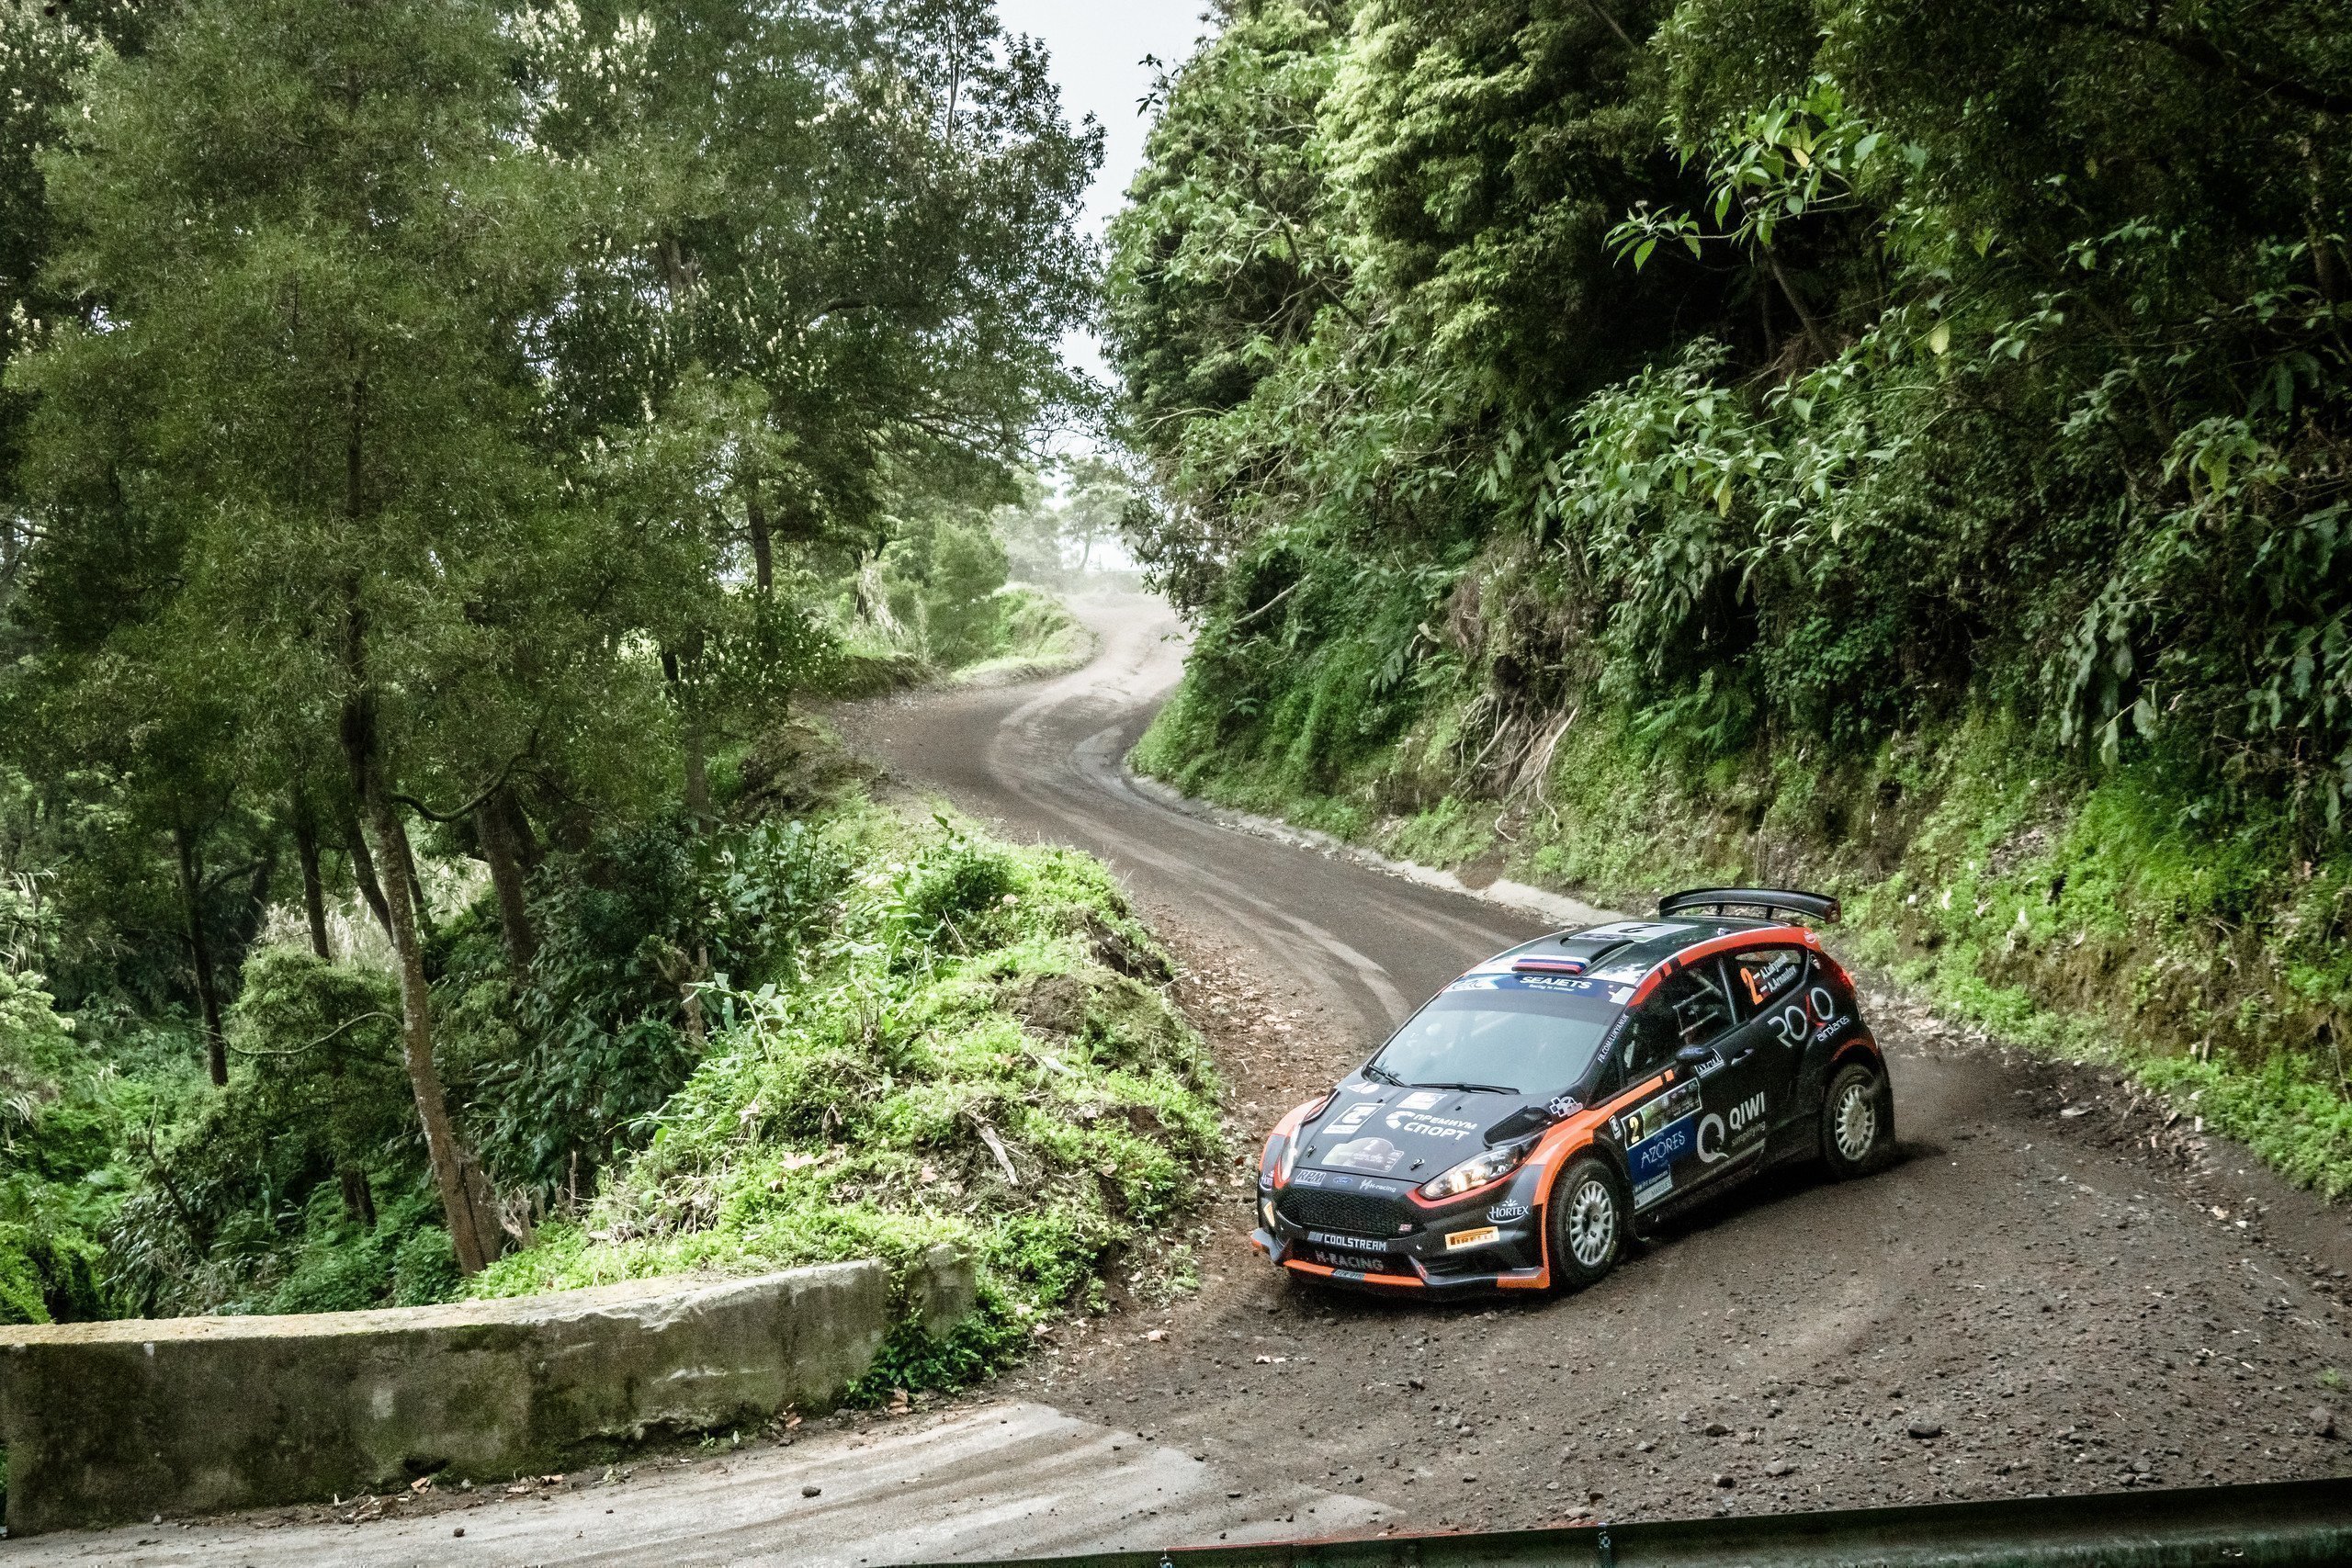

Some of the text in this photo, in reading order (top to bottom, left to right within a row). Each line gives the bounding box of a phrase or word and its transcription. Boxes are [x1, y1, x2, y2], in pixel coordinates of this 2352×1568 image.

[1519, 976, 1592, 989] SEAJETS
[1740, 967, 1763, 1005] 2
[1816, 1015, 1849, 1043] airplanes
[1729, 1091, 1765, 1131] QIWI
[1412, 1113, 1478, 1131] ПРЕМИУМ
[1629, 1116, 1640, 1144] 2
[1403, 1122, 1470, 1142] СПОРТ
[1640, 1130, 1687, 1169] AZORES
[1297, 1170, 1325, 1184] RPM
[1369, 1182, 1397, 1193] H-racing
[1488, 1205, 1530, 1220] HORTEX
[1323, 1233, 1387, 1252] COOLSTREAM
